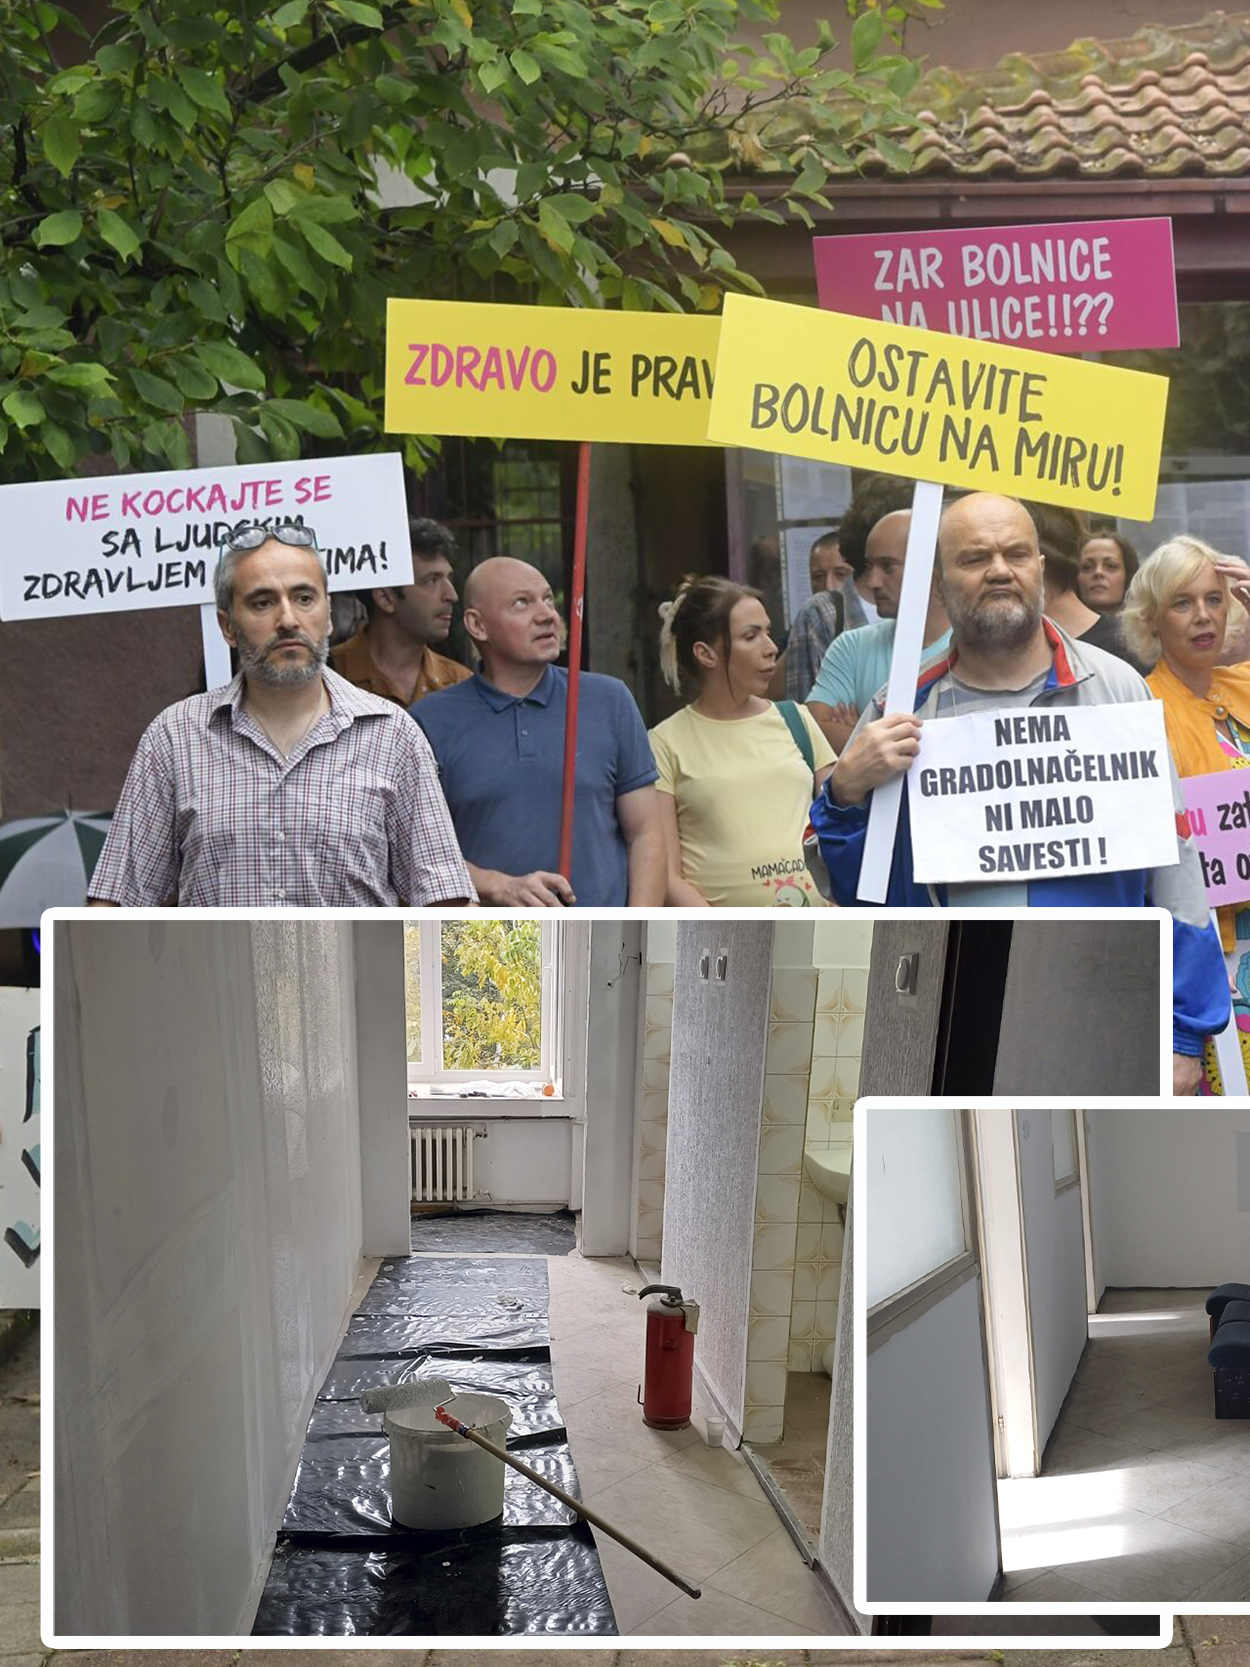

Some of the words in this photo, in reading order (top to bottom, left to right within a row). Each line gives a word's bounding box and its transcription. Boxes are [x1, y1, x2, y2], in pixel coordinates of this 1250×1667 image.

[873, 247, 945, 293] ZAR
[961, 236, 1113, 287] BOLNICE
[947, 292, 1115, 341] ULICE!!??
[404, 343, 557, 393] ZDRAVO
[571, 350, 612, 395] JE
[847, 337, 1047, 424] OSTAVITE
[750, 382, 929, 456] BOLNICU
[939, 413, 1000, 473] NA
[1013, 427, 1125, 497] MIRU!
[65, 494, 110, 522] NE
[121, 479, 283, 519] KOCKAJTE
[294, 475, 333, 504] SE
[101, 528, 141, 558] SA
[23, 560, 206, 602] ZDRAVLJEM
[994, 714, 1071, 747] NEMA
[920, 749, 1159, 798] GRADOLNAČELNIK
[984, 803, 1013, 832] NI
[1020, 795, 1094, 829] MALO
[978, 837, 1091, 873] SAVESTI
